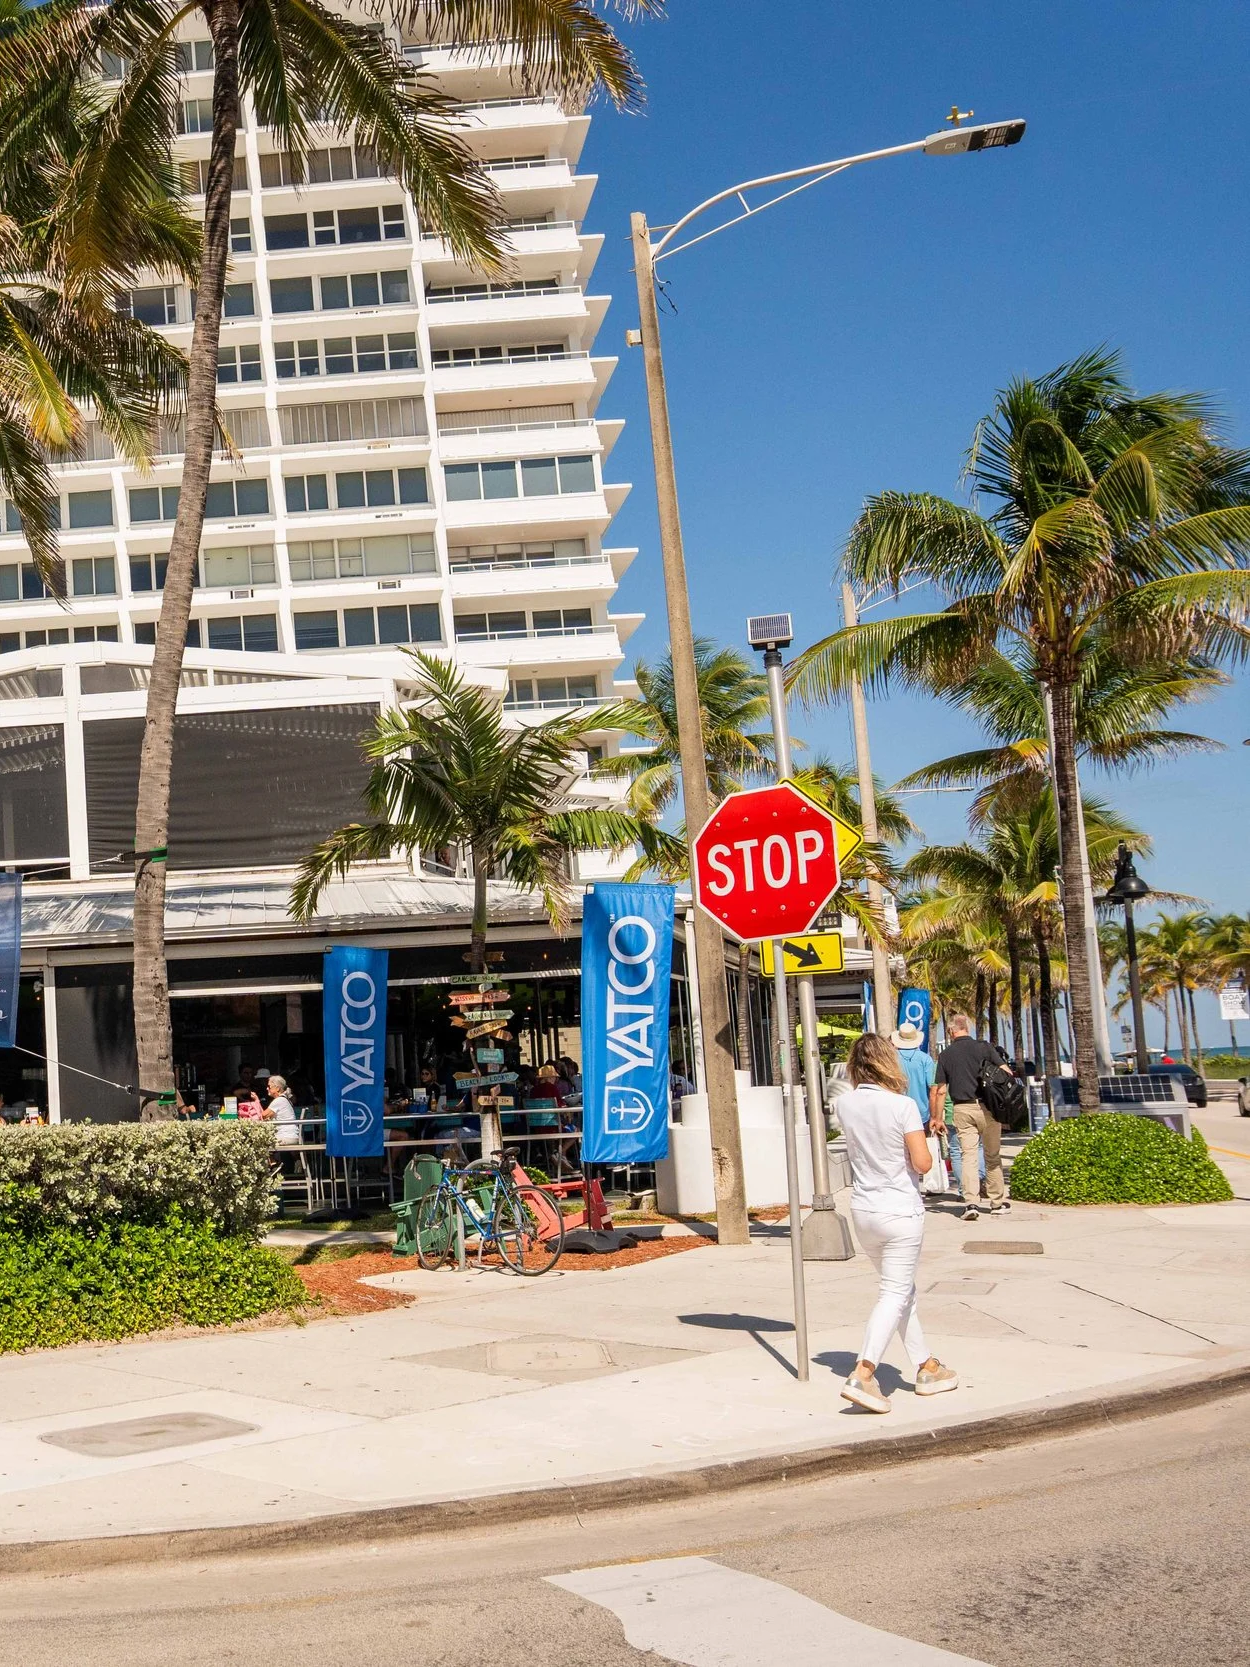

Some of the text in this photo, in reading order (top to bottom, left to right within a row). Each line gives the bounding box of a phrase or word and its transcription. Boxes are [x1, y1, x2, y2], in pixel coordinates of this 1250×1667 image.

[707, 829, 825, 897] STOP
[341, 971, 377, 1097] YATCO
[606, 916, 656, 1083] YATCO
